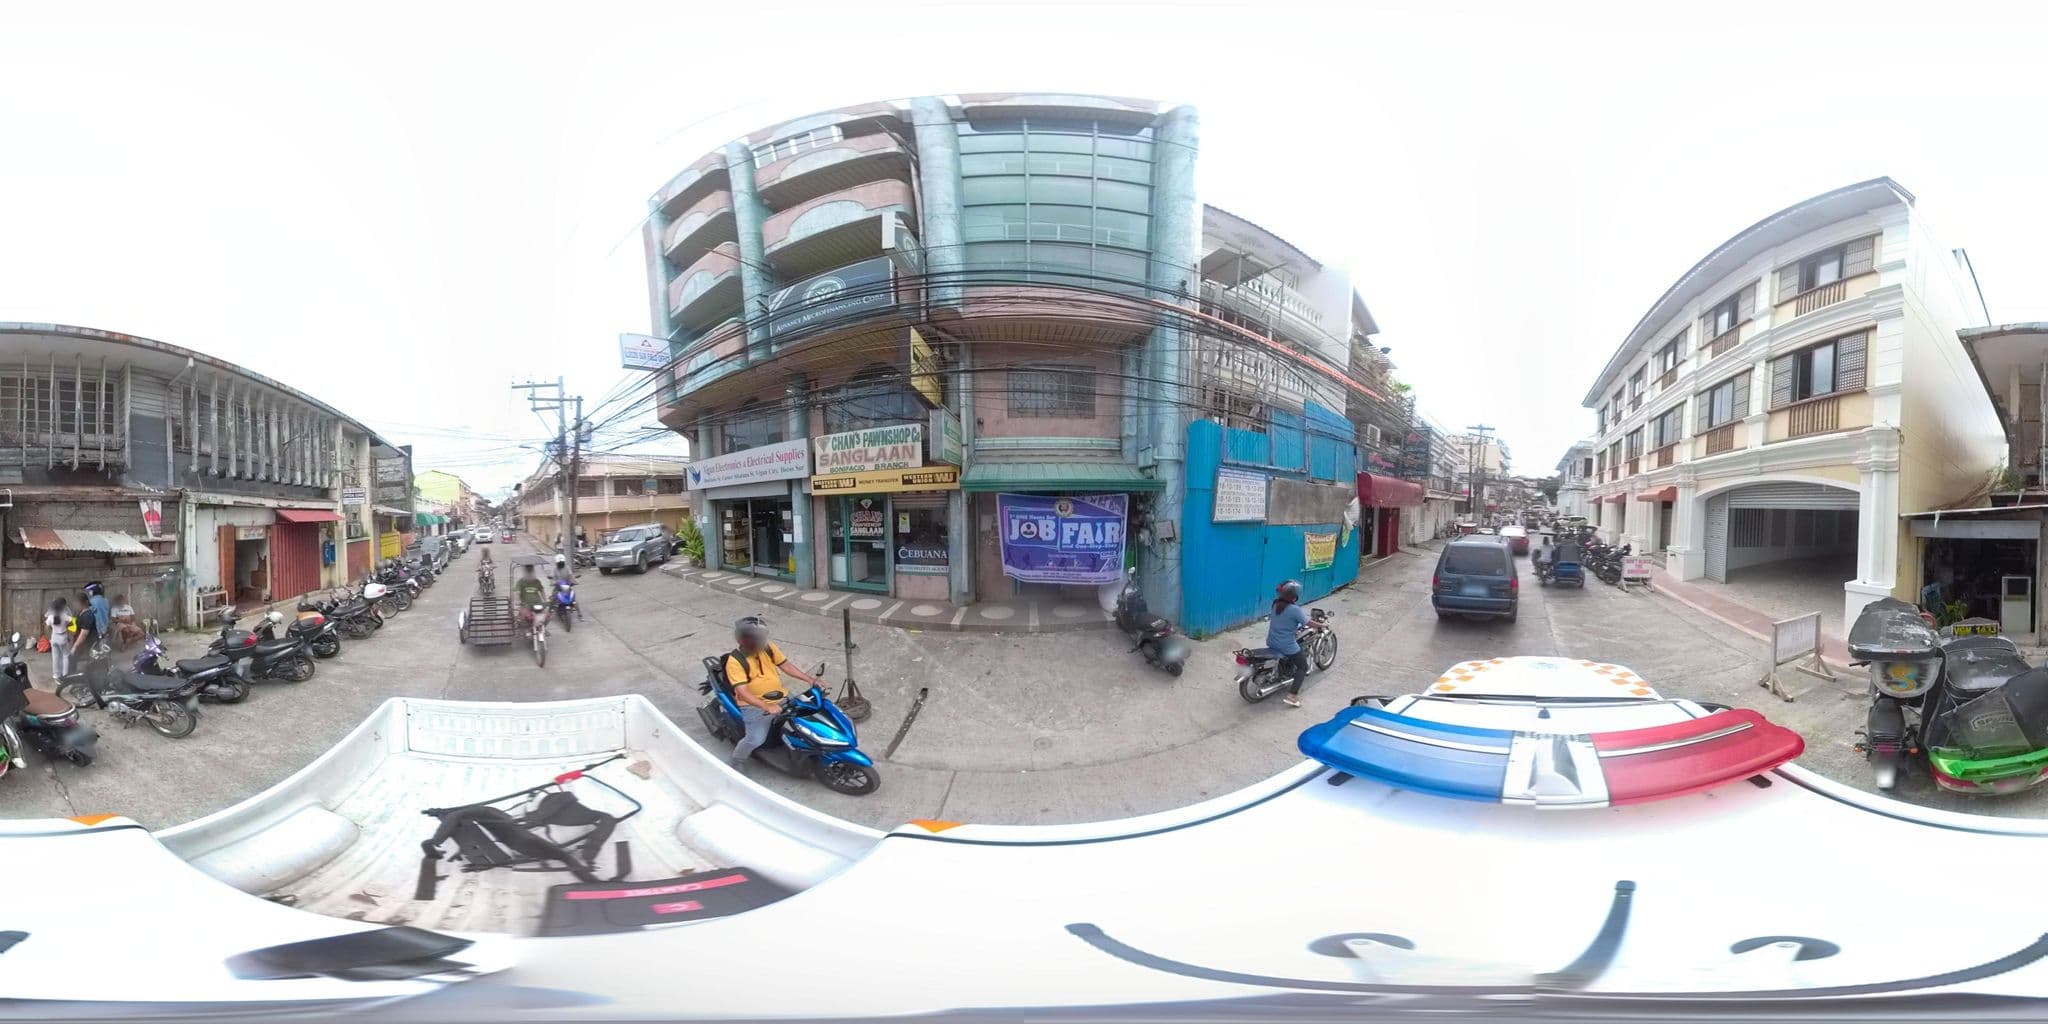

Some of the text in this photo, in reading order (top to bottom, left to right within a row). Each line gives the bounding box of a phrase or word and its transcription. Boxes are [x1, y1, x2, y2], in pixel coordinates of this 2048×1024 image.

[863, 428, 911, 448] PAWNSHOP
[746, 453, 775, 467] Electrical
[775, 449, 805, 464] Supplies
[820, 445, 915, 467] SANGLAAN
[830, 461, 909, 474] BONIFACIO BRANCH
[1010, 519, 1121, 544] JOB FAIR
[898, 546, 947, 559] CEBUANA
